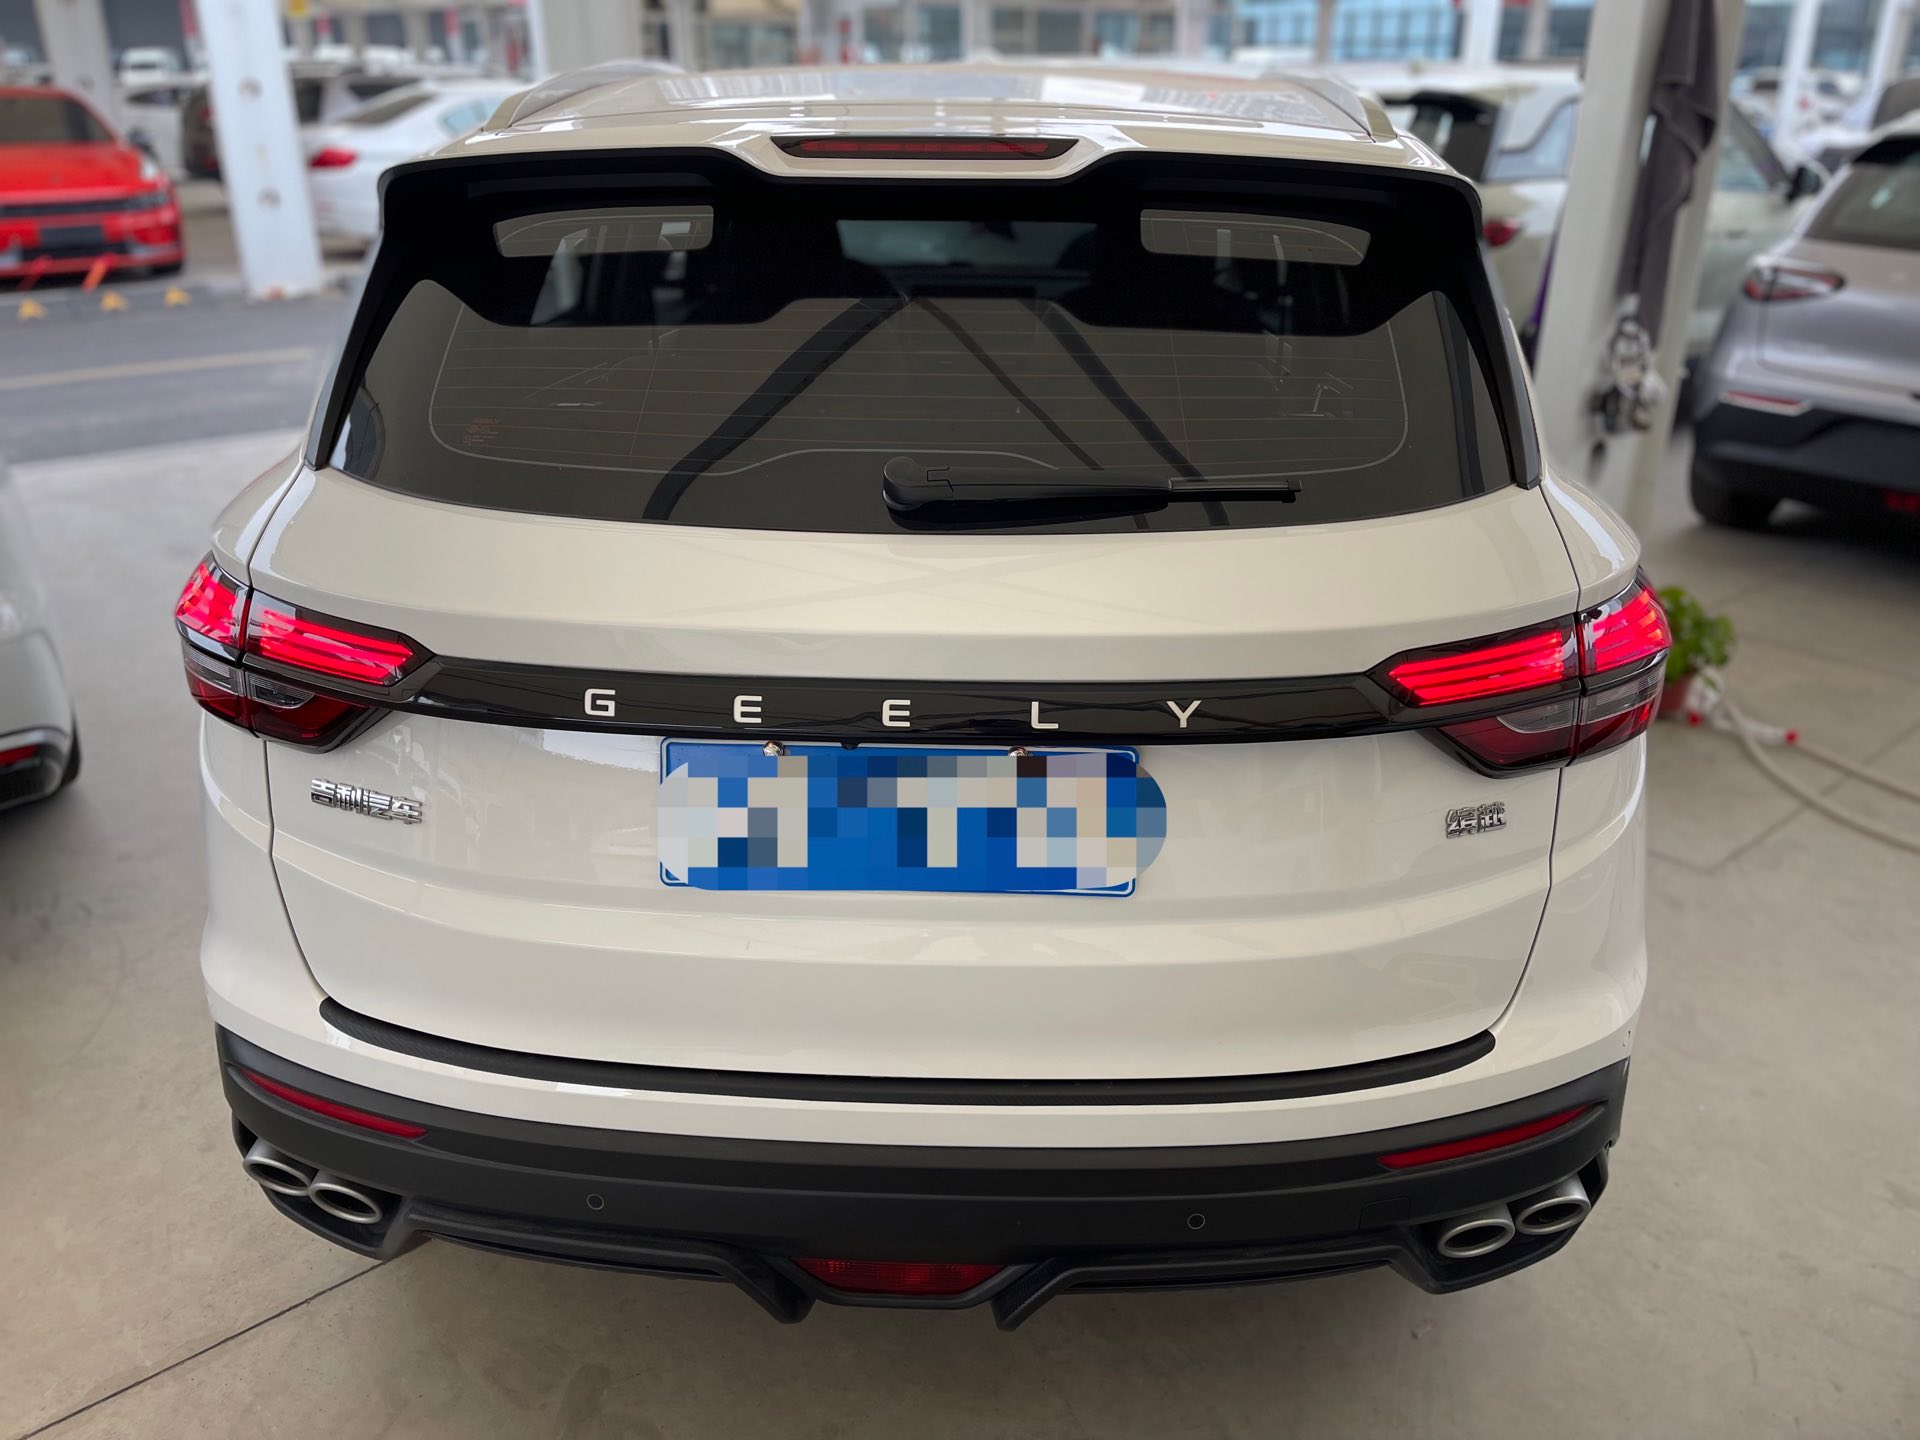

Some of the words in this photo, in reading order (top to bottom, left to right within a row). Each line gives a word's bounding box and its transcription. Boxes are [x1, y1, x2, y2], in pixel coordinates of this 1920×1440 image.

[584, 688, 1202, 730] GEELY
[311, 778, 423, 825] 吉利汽车
